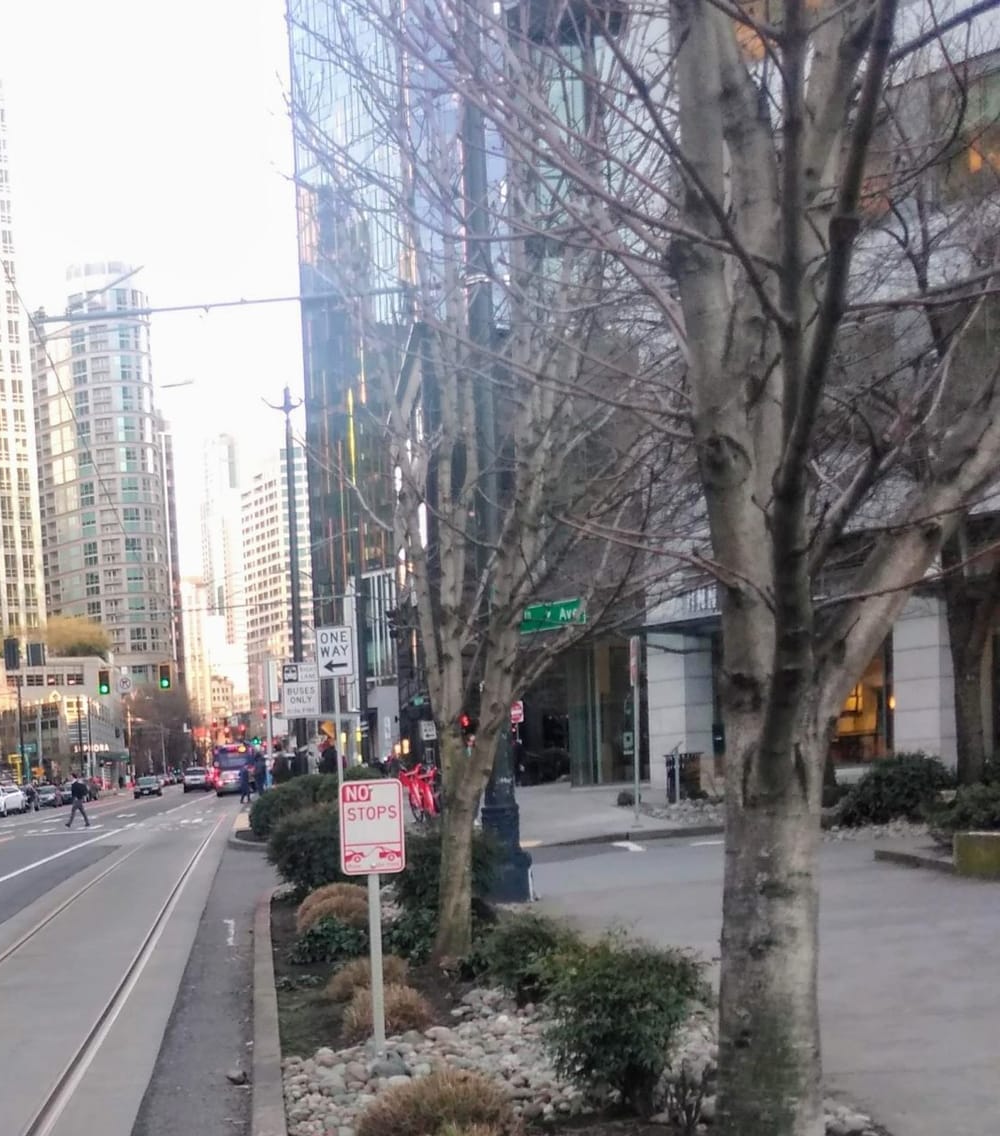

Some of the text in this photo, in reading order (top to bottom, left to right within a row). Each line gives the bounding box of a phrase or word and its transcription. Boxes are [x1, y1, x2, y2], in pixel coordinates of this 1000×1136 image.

[320, 631, 348, 644] ONE
[320, 645, 349, 658] WAY
[287, 686, 316, 696] BUSES
[290, 696, 313, 704] ONLY
[345, 785, 369, 801] NO
[347, 805, 397, 821] STOPS
